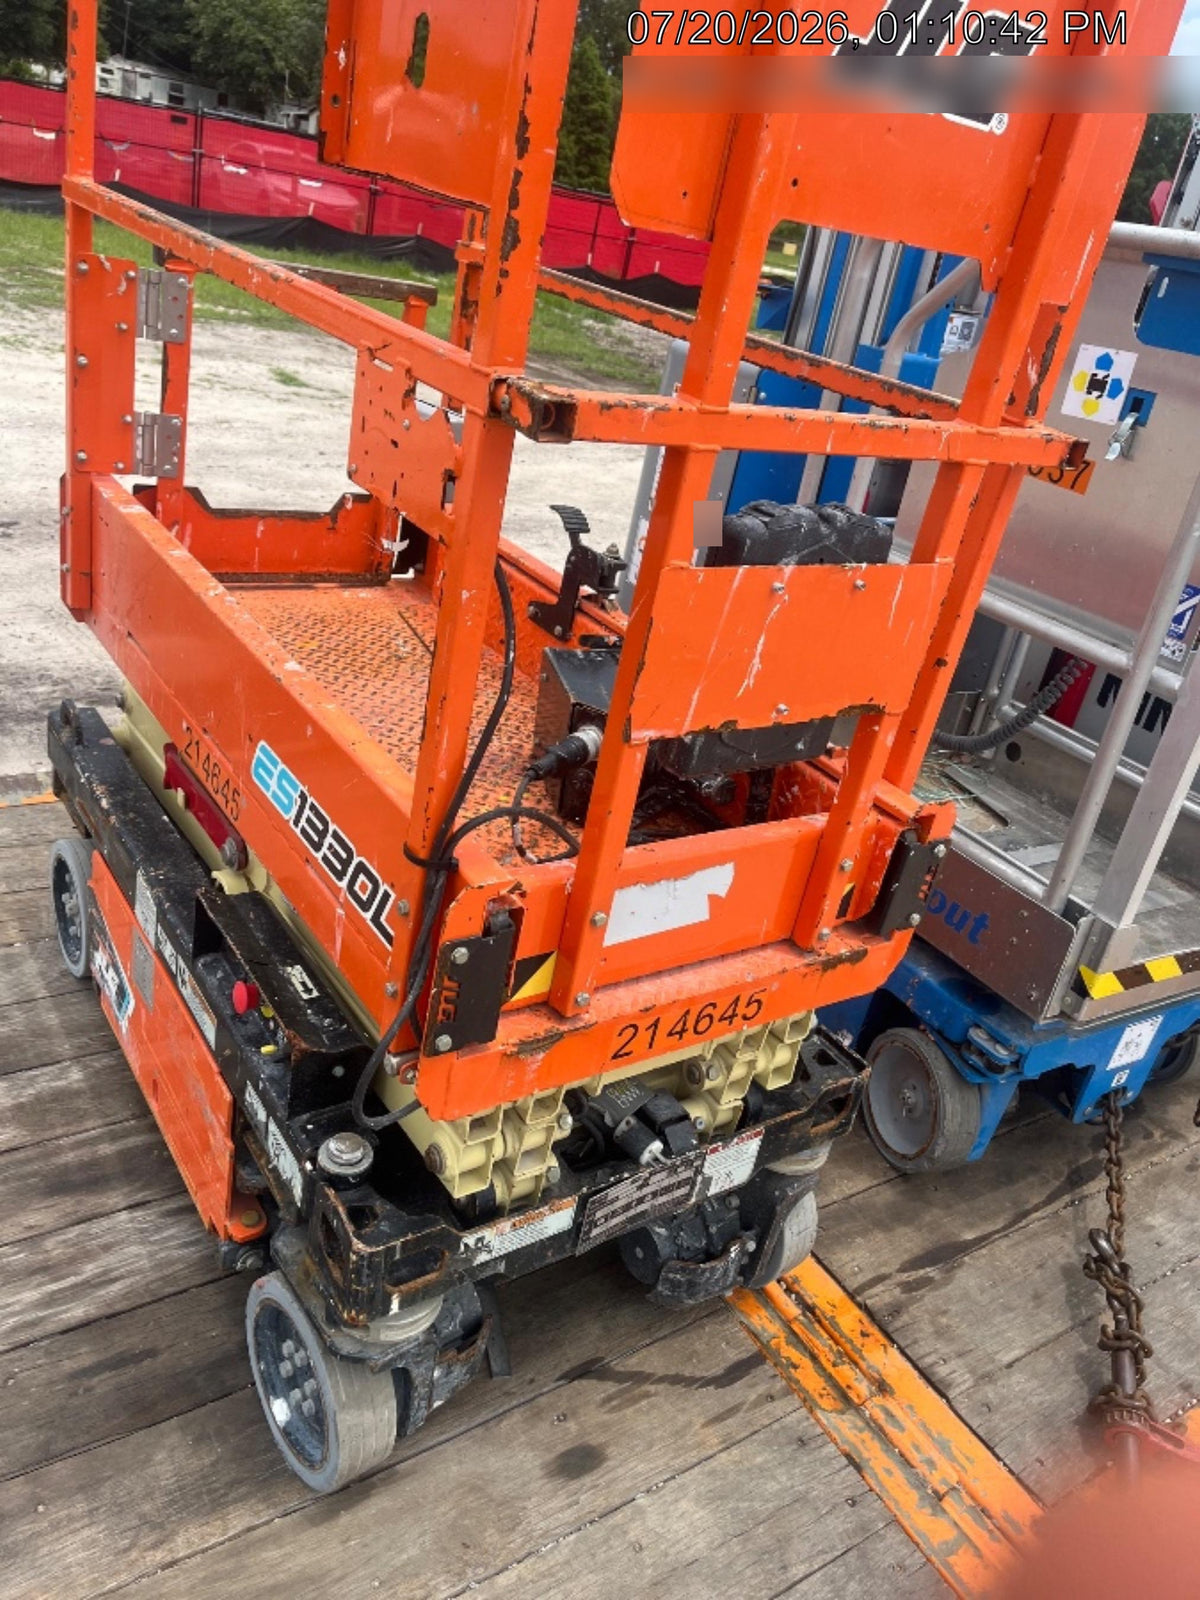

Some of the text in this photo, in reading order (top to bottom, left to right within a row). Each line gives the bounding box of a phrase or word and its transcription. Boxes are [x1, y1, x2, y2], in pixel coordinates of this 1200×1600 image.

[184, 726, 241, 822] 214645
[252, 740, 395, 949] ES1330L
[611, 988, 766, 1060] 214645
